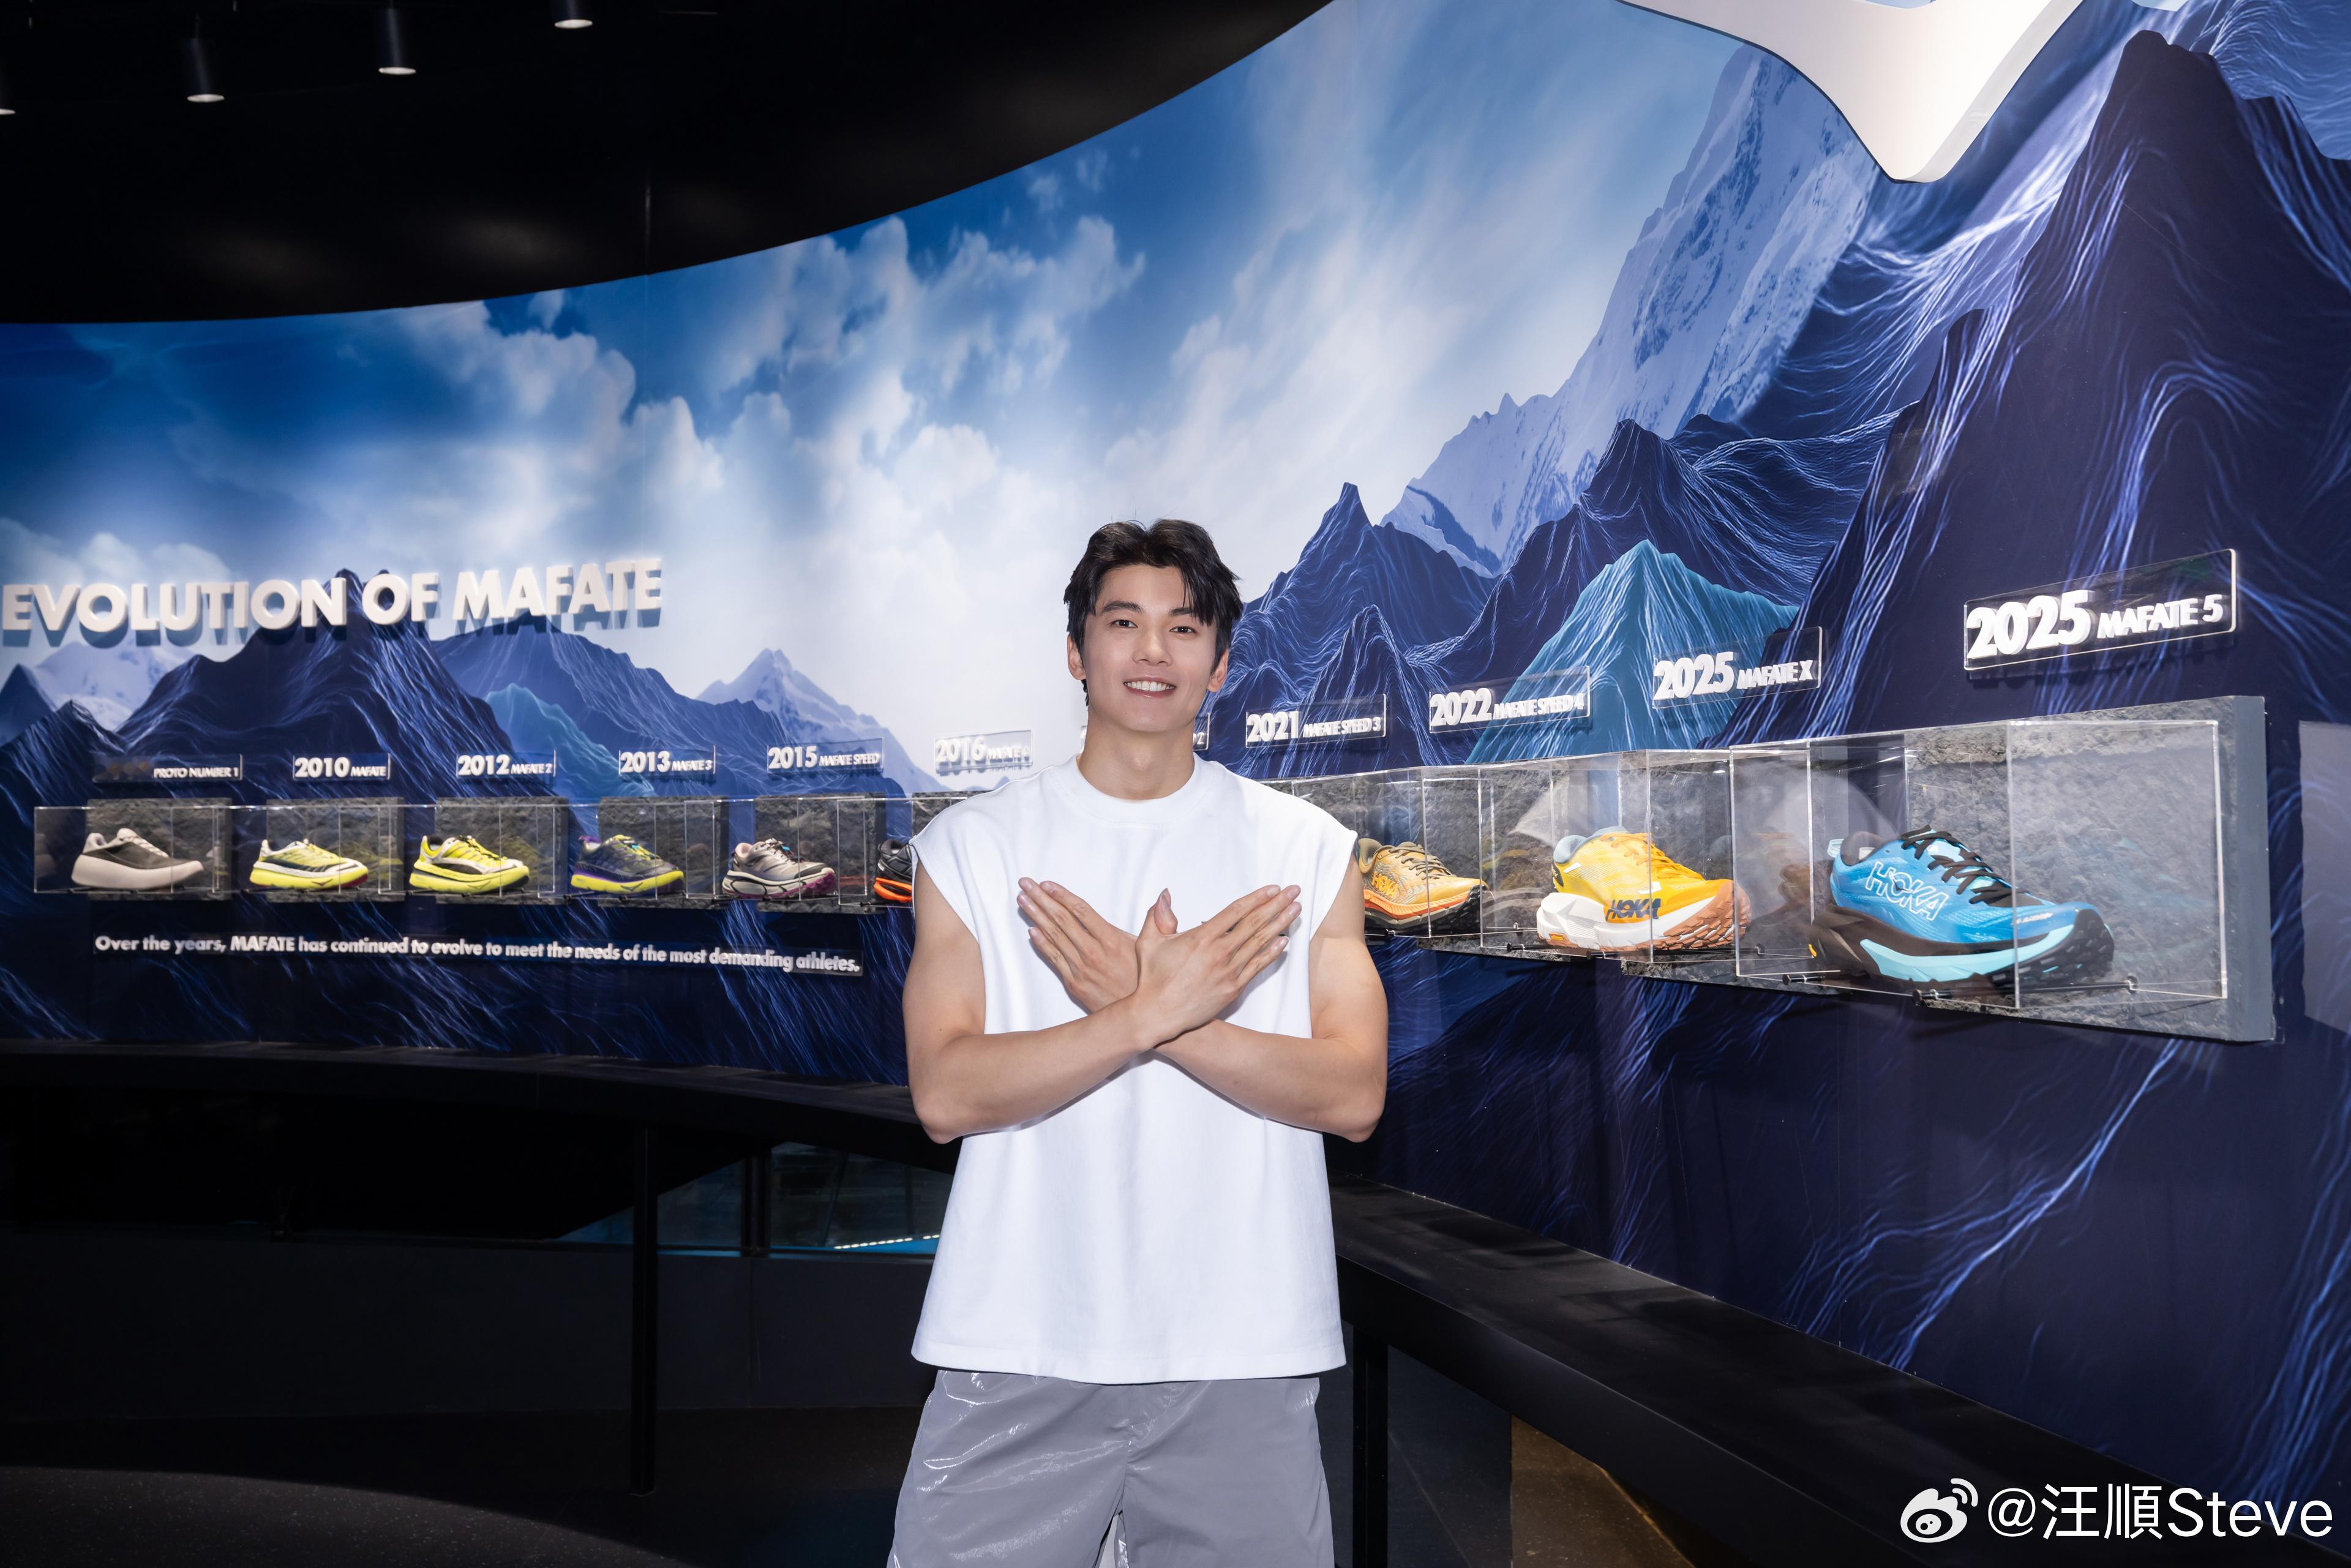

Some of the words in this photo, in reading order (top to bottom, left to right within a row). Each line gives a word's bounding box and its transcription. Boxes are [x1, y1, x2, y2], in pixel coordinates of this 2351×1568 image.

[2, 577, 347, 632] EVOLUTION
[361, 572, 439, 625] OF
[452, 558, 662, 621] MAFATE
[1966, 590, 2093, 659] 2025
[2096, 598, 2199, 639] MAFATE
[2202, 594, 2224, 623] 5
[1653, 651, 1734, 700] 2025
[1736, 662, 1799, 689] MAFATE
[1798, 659, 1813, 681] X
[1430, 688, 1492, 726] 2022
[1493, 699, 1537, 720] MAFATE
[1537, 694, 1573, 715] SPEED
[1573, 692, 1584, 710] 4
[1196, 732, 1205, 745] 2
[1247, 710, 1300, 742] 2021
[1302, 721, 1341, 738] MAFATE
[1341, 717, 1371, 734] SPEED
[1372, 716, 1381, 731] 3
[620, 751, 670, 773] 2013
[671, 760, 704, 771] MAFATE
[705, 759, 713, 771] 3
[768, 745, 818, 770] 2015
[819, 754, 852, 767] MAFATE
[853, 752, 880, 765] SPEED
[935, 736, 985, 763] 2016
[153, 768, 186, 778] PROTO
[189, 767, 231, 778] NUMBER
[233, 767, 239, 777] 1
[294, 757, 350, 778] 2010
[350, 766, 387, 777] MAFATE
[457, 754, 511, 776] 2012
[511, 763, 544, 775] MAFATE
[545, 763, 553, 773] 2
[1371, 871, 1400, 899] HOKA
[1865, 861, 1950, 921] HOKA
[1605, 898, 1661, 920] HOKA
[95, 936, 140, 951] Over
[143, 934, 170, 951] the
[174, 939, 226, 955] years,
[230, 936, 295, 951] MAFATE
[298, 936, 328, 952] has
[330, 937, 408, 953] continued
[411, 939, 429, 954] to
[431, 938, 482, 955] evolve
[486, 942, 503, 956] to
[505, 943, 544, 958] meet
[547, 941, 572, 958] the
[574, 943, 621, 960] needs
[623, 943, 640, 961] of
[642, 944, 667, 962] the
[670, 949, 707, 964] most
[709, 947, 793, 972] demanding
[796, 951, 860, 972] athletes.
